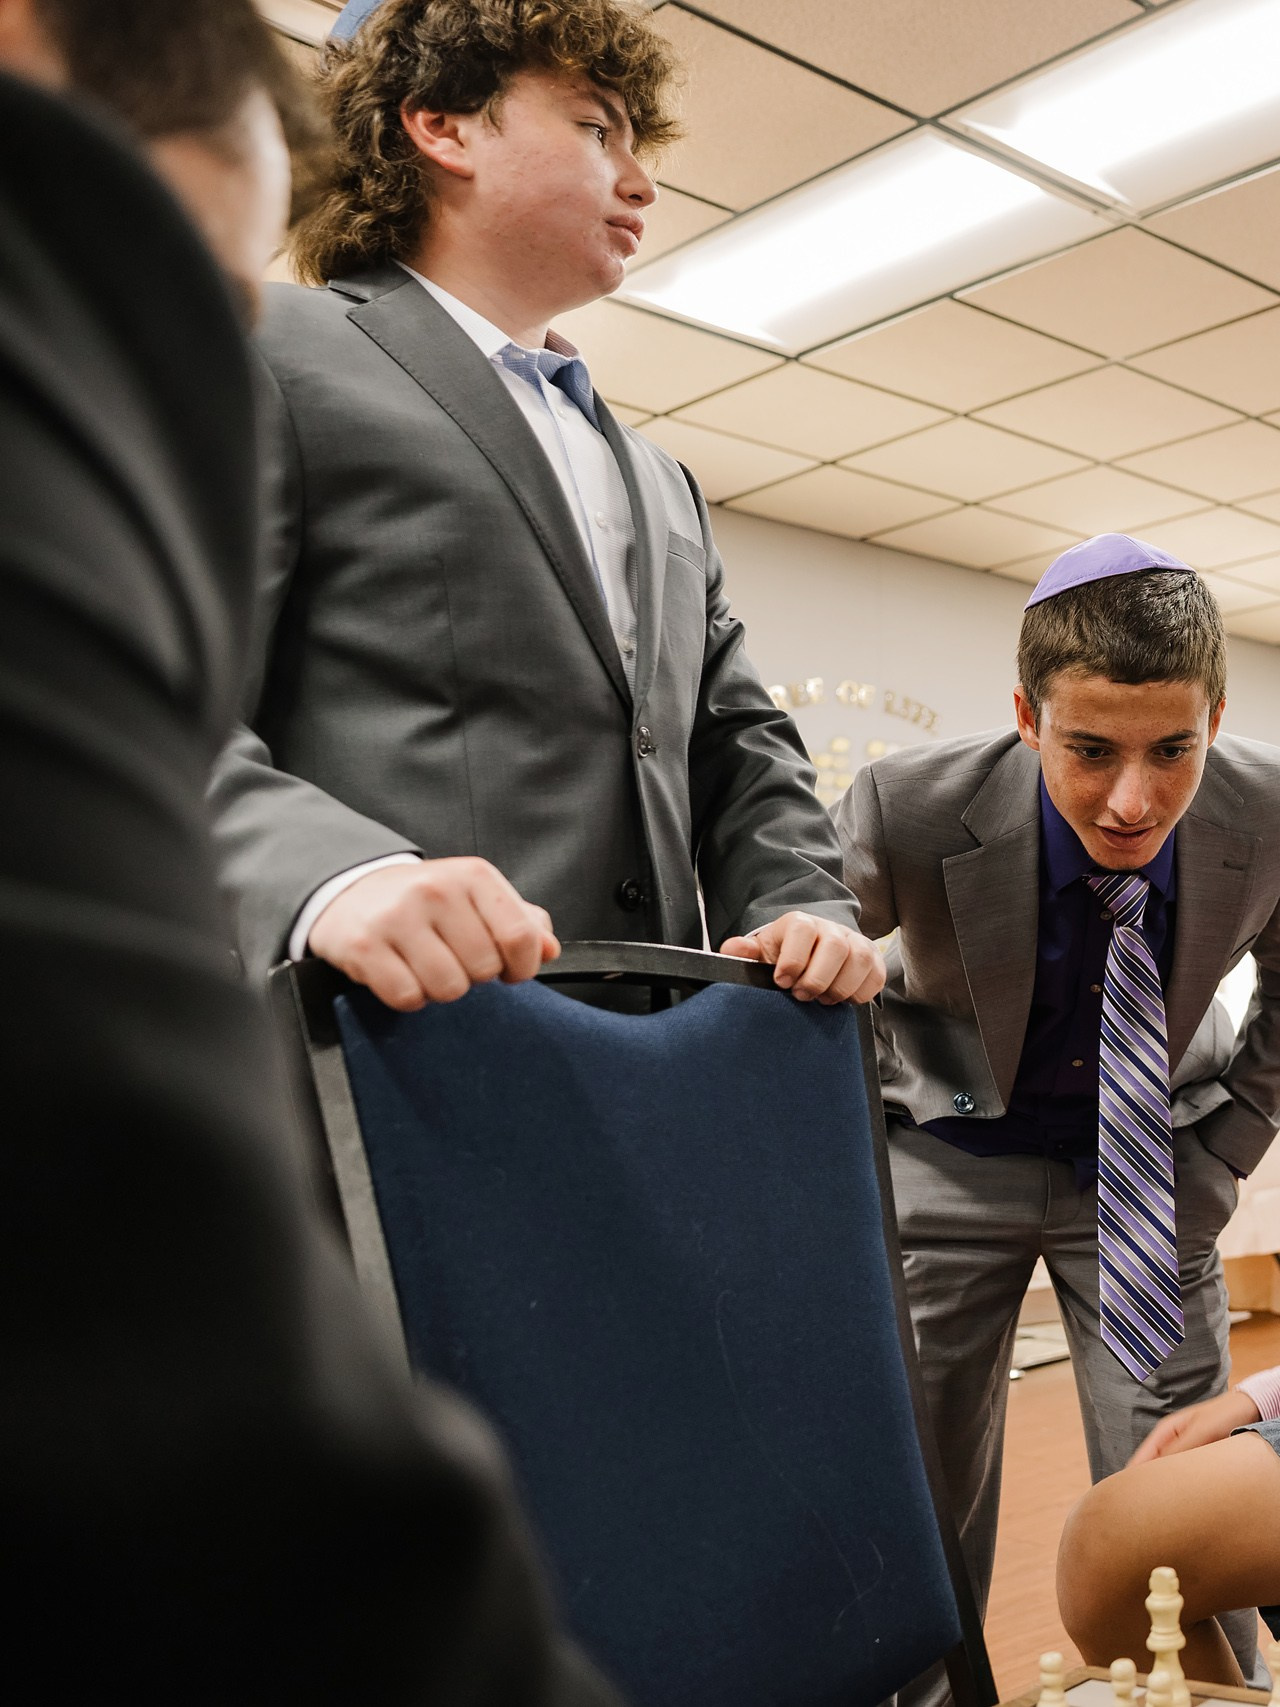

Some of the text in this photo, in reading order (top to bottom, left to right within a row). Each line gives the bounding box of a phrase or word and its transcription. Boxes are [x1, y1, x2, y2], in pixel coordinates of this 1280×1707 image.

[767, 677, 940, 733] REE OF LIFE
